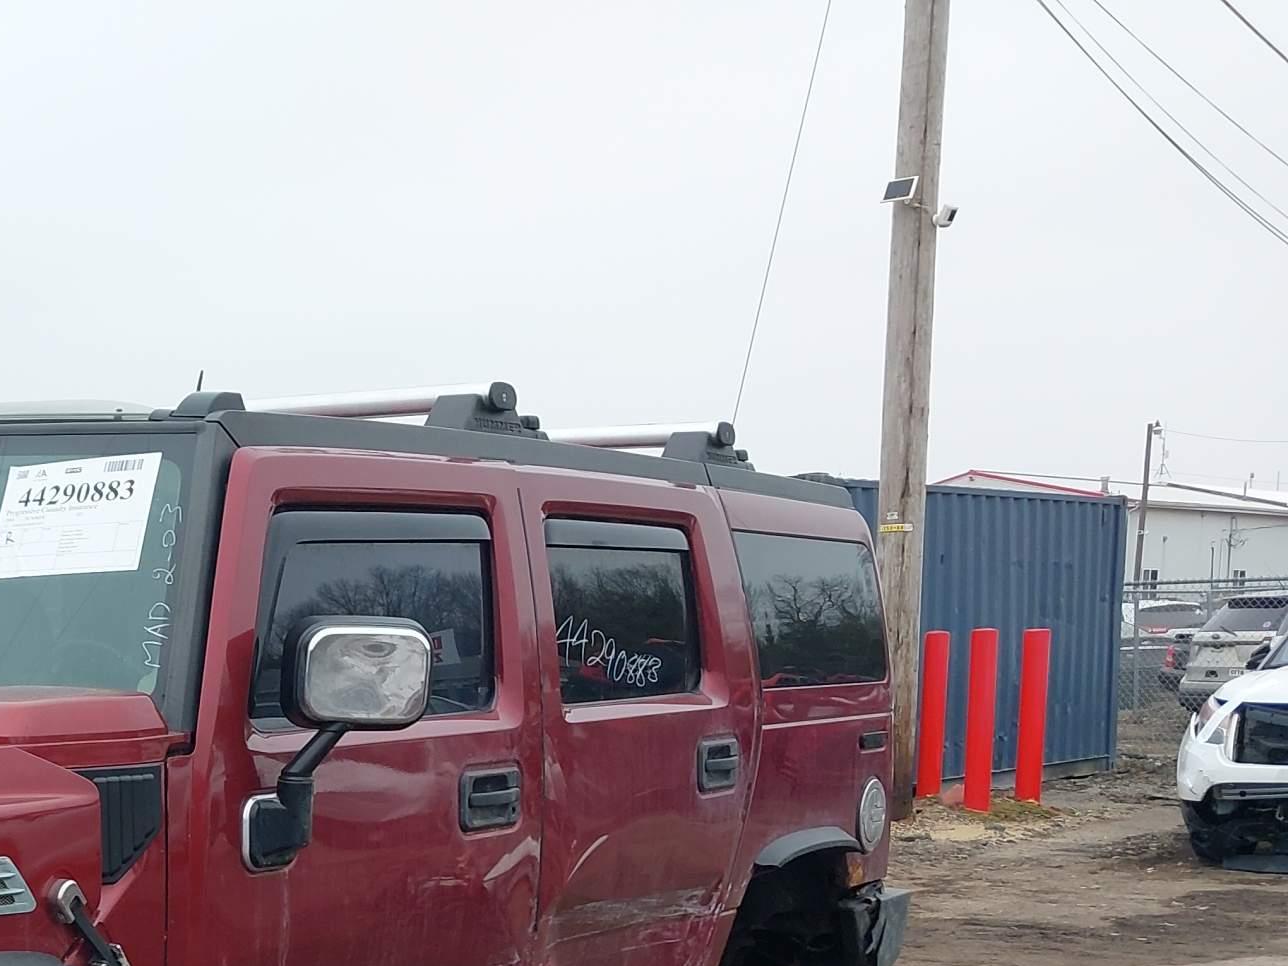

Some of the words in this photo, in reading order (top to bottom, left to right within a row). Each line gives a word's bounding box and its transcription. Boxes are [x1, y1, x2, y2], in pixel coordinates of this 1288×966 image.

[18, 479, 135, 507] 44290883
[142, 602, 171, 668] MAD
[555, 615, 662, 687] 44290883
